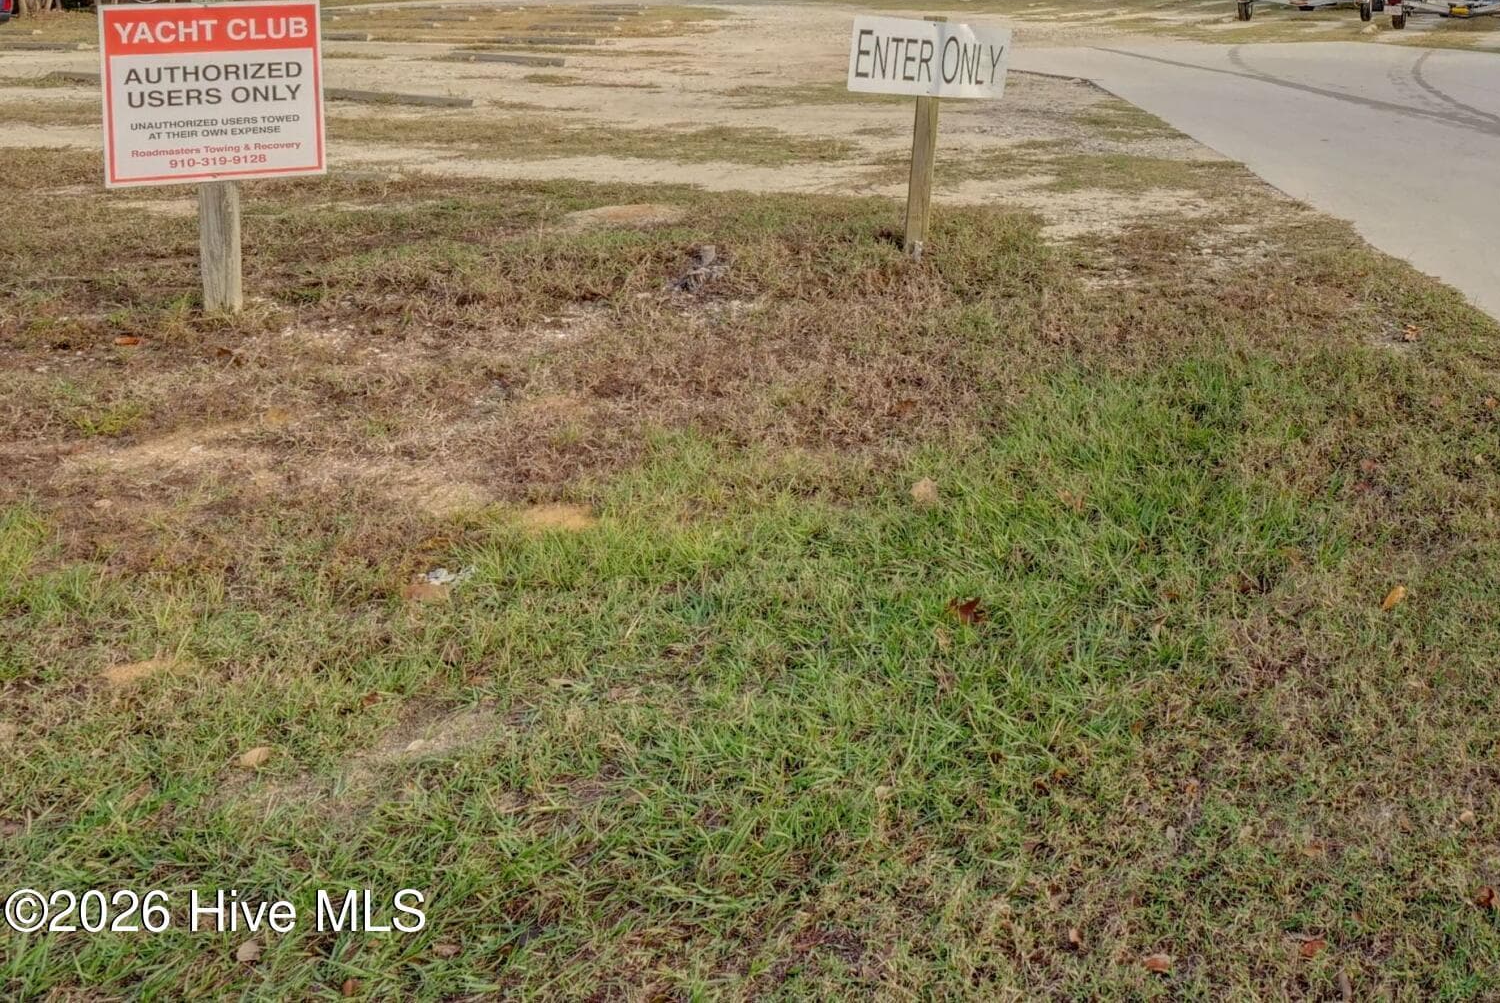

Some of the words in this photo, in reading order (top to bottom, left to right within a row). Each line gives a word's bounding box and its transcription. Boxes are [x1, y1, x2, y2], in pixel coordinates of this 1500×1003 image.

[114, 20, 218, 45] YACHT
[227, 17, 308, 40] CLUB
[855, 29, 934, 82] ENTER
[942, 36, 1003, 85] ONLY
[124, 61, 302, 85] AUTHORIZED
[128, 89, 221, 108] USERS
[231, 84, 302, 103] ONLY
[130, 120, 218, 130] UNAUTHORIZED
[221, 117, 257, 125] USERS
[261, 115, 300, 124] TOWED
[149, 132, 163, 140] AT
[165, 130, 198, 139] THEIR
[201, 129, 228, 137] OWN
[231, 125, 281, 135] EXPENSE
[131, 147, 200, 158] Roadmasters
[203, 145, 240, 155] Towing
[255, 142, 301, 153] Recovery
[169, 154, 267, 169] 910-319-9128
